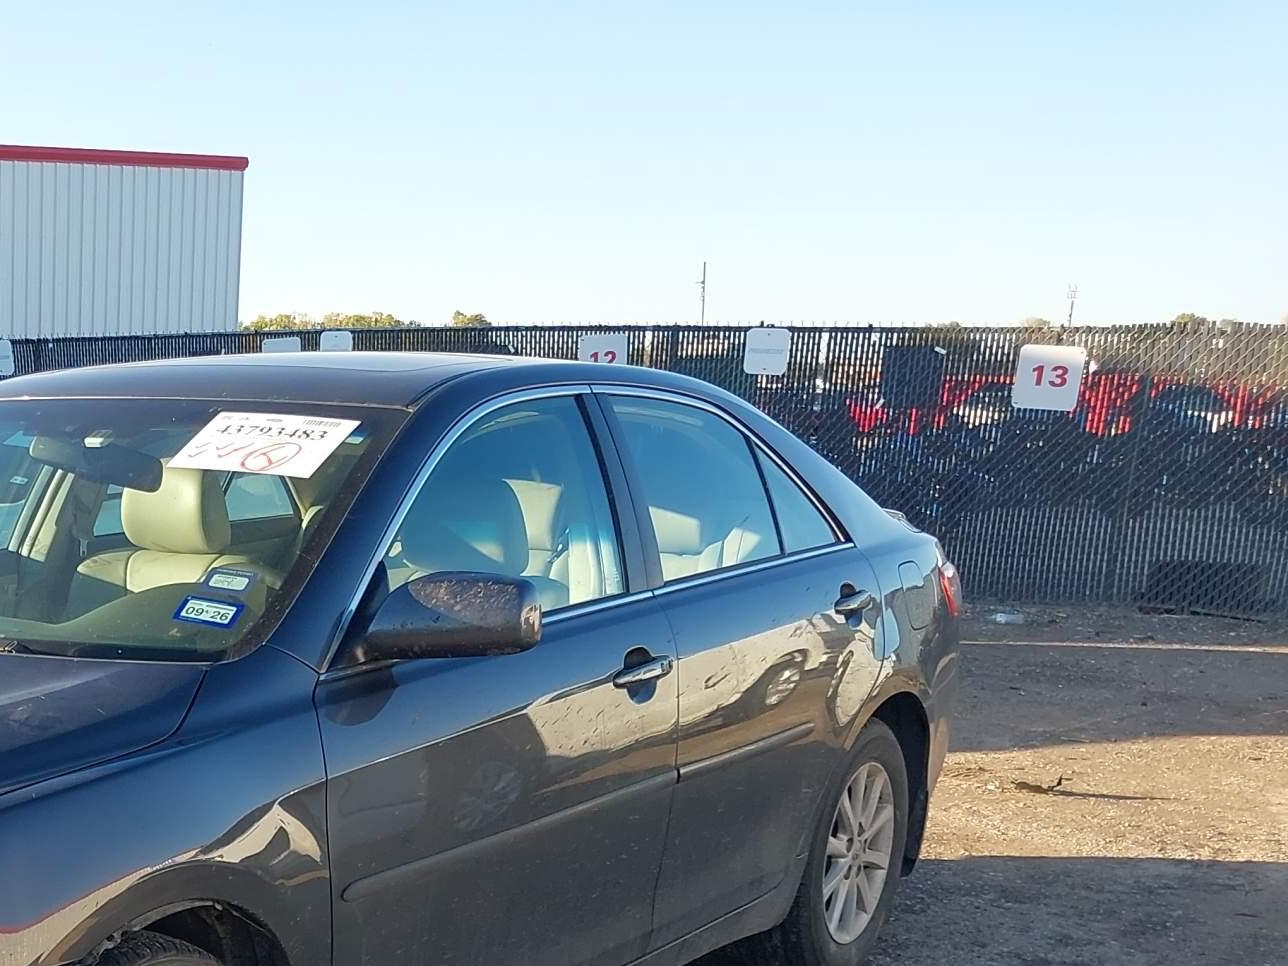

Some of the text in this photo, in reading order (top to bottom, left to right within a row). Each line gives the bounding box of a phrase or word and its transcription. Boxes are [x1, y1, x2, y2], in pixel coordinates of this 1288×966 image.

[590, 350, 617, 363] 12
[1032, 365, 1069, 388] 13
[216, 424, 328, 441] 43793483
